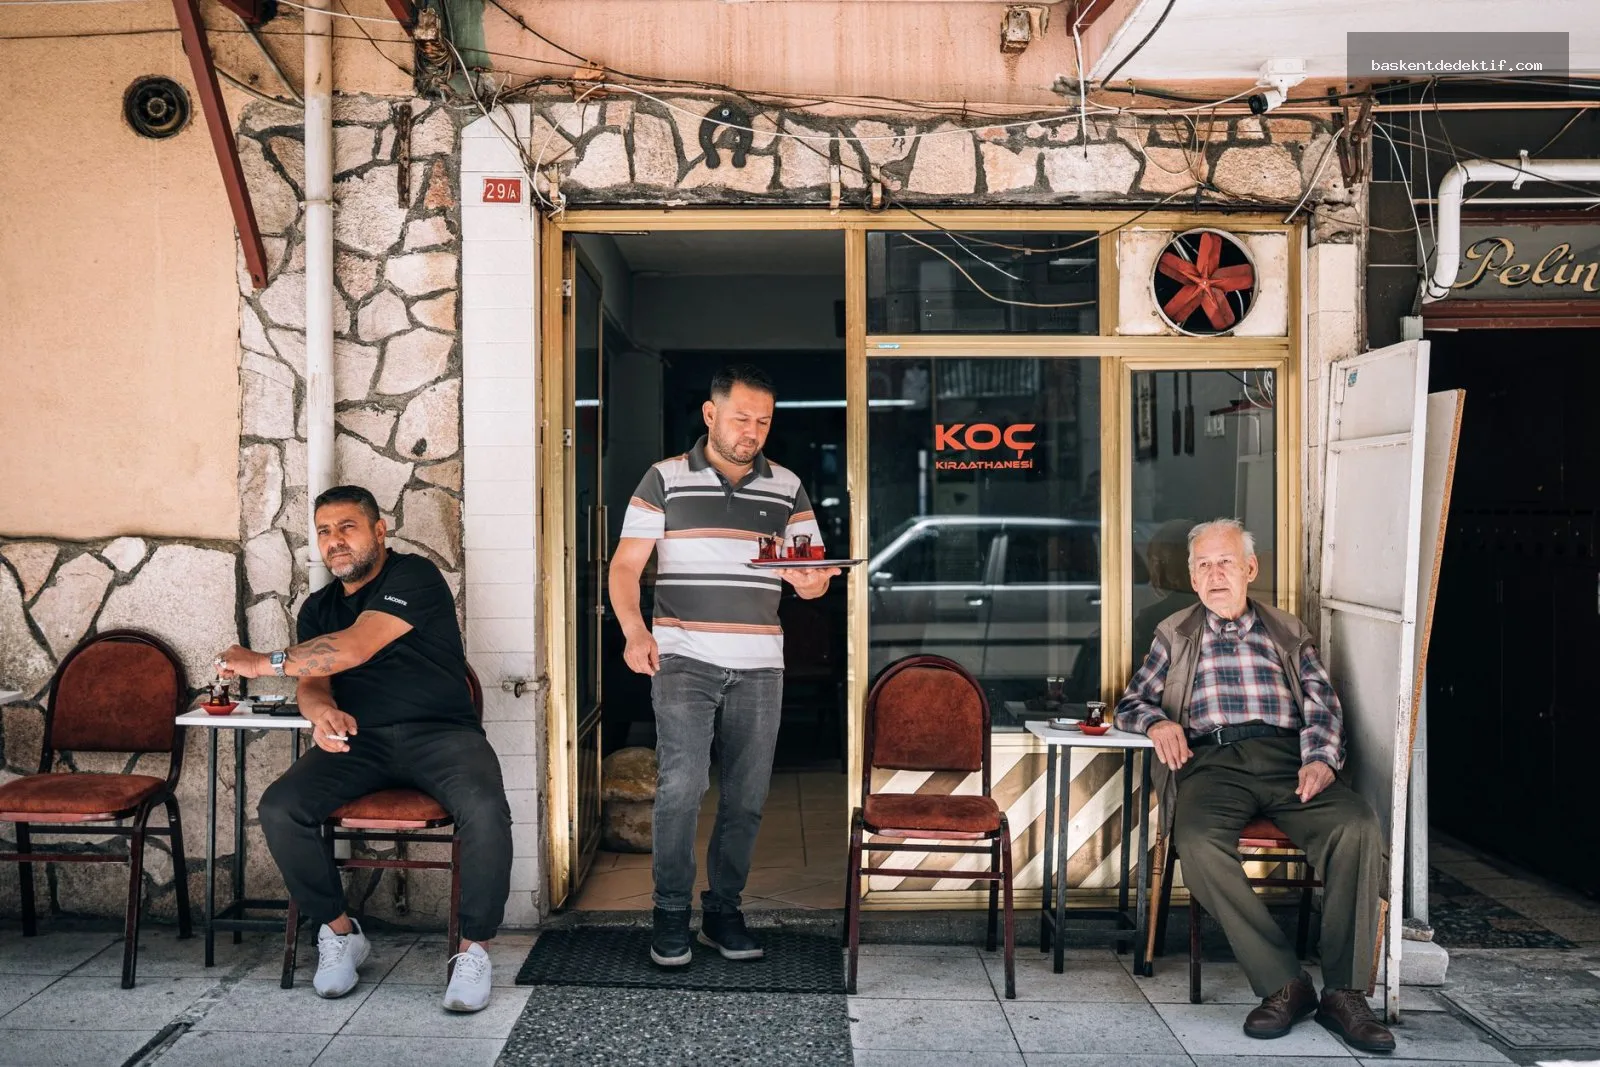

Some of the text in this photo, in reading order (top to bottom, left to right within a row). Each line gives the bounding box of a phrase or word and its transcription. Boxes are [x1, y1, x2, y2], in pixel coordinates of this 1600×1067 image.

[486, 183, 517, 199] 29/A
[1452, 236, 1600, 292] Pelin
[935, 423, 1036, 460] KOÇ
[935, 458, 1033, 470] KIRAATHANESİ
[384, 595, 408, 606] LACOSTE
